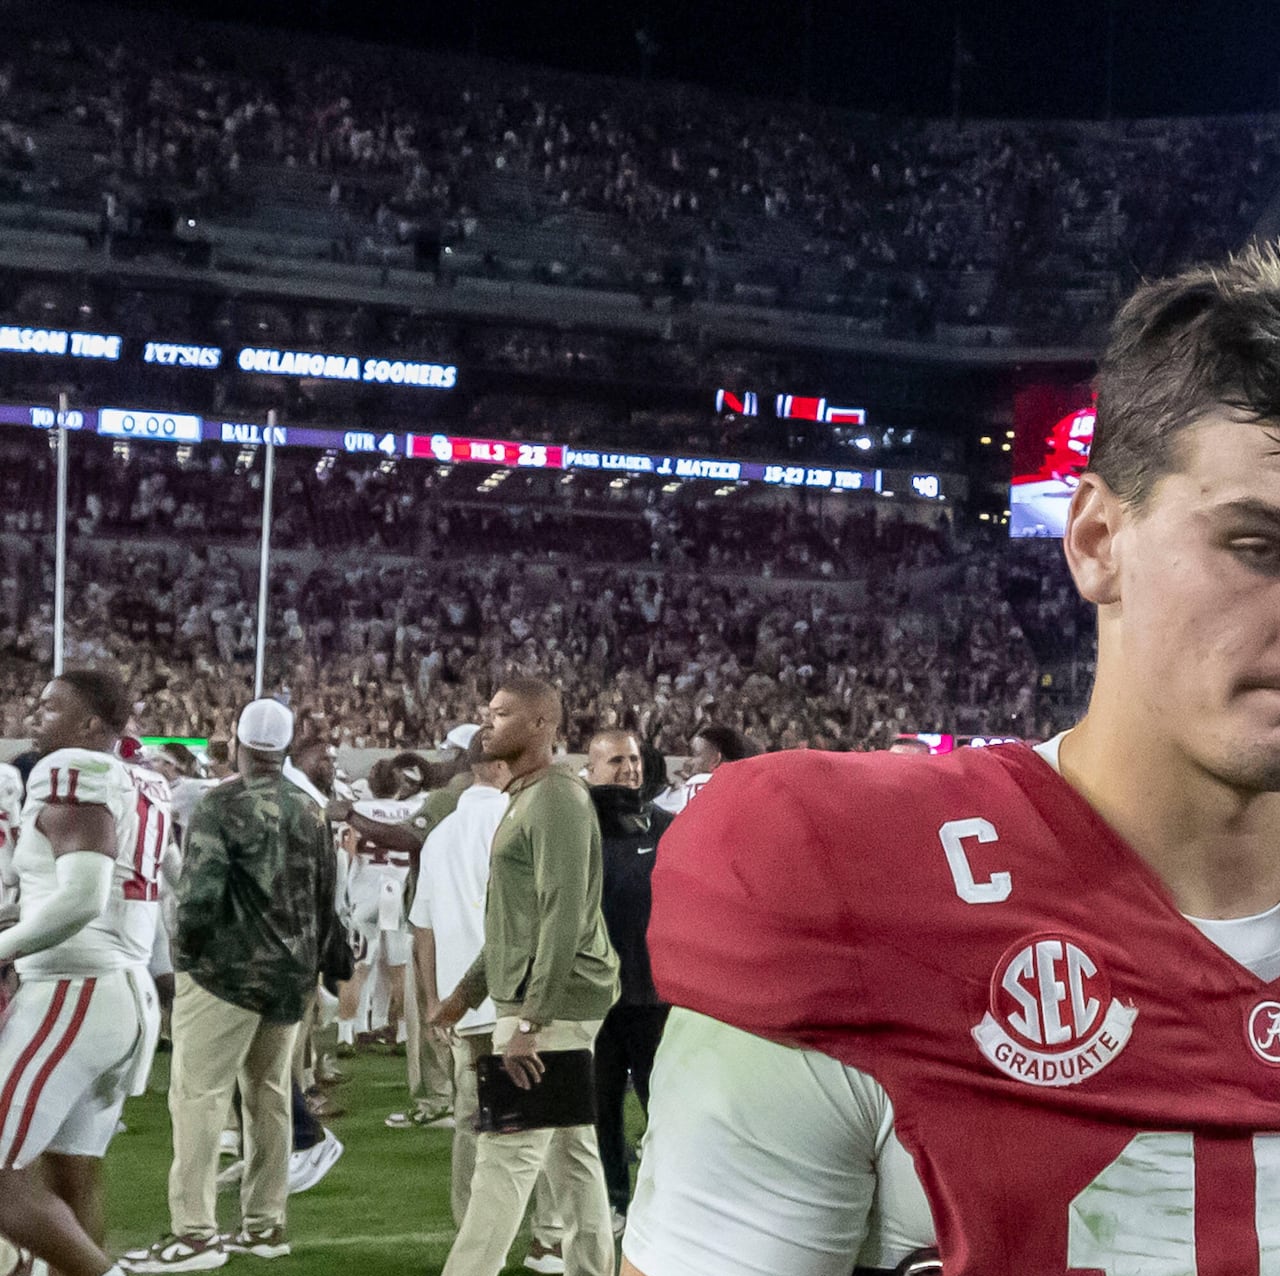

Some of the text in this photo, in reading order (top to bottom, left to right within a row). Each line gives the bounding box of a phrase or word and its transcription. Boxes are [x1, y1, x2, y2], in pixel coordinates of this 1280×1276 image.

[71, 334, 120, 359] TIDE
[239, 348, 457, 388] OKLAHOMA SOONERS
[222, 423, 262, 444] BALL
[344, 432, 396, 455] QTR 4
[518, 445, 548, 467] 23
[566, 451, 600, 468] PASS
[51, 768, 80, 803] 11
[940, 816, 1012, 904] C
[1002, 939, 1100, 1046] SEC
[994, 1030, 1119, 1081] GRADUATE
